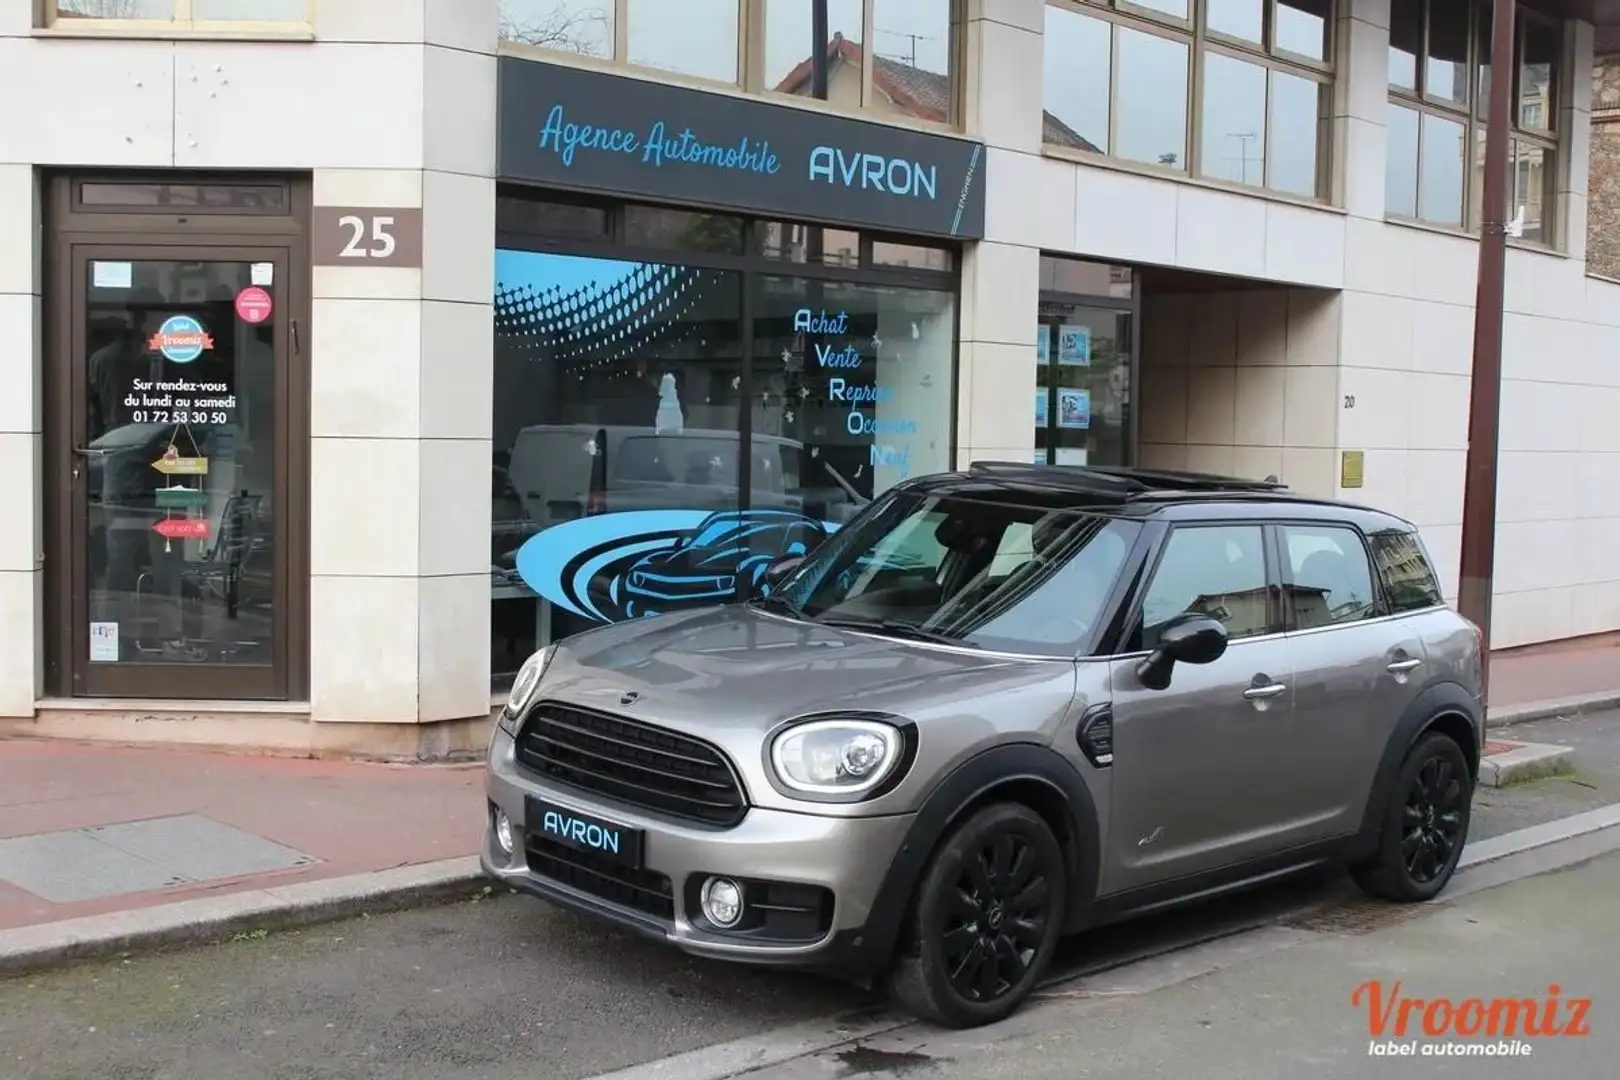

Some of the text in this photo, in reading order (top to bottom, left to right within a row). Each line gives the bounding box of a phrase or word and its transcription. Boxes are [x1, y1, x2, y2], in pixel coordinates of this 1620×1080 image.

[540, 104, 781, 174] Agence Automobile
[809, 145, 936, 199] AVRON
[338, 215, 395, 258] 25
[794, 308, 848, 334] Achat
[814, 343, 862, 368] Vente
[133, 378, 227, 392] Sur rendez-vous
[829, 377, 895, 411] Repri
[124, 394, 236, 408] du lundi au samedi
[1344, 395, 1356, 409] 20
[133, 411, 227, 424] 01 72 53 30 50
[847, 411, 917, 435] Occion
[543, 811, 620, 854] AVRON
